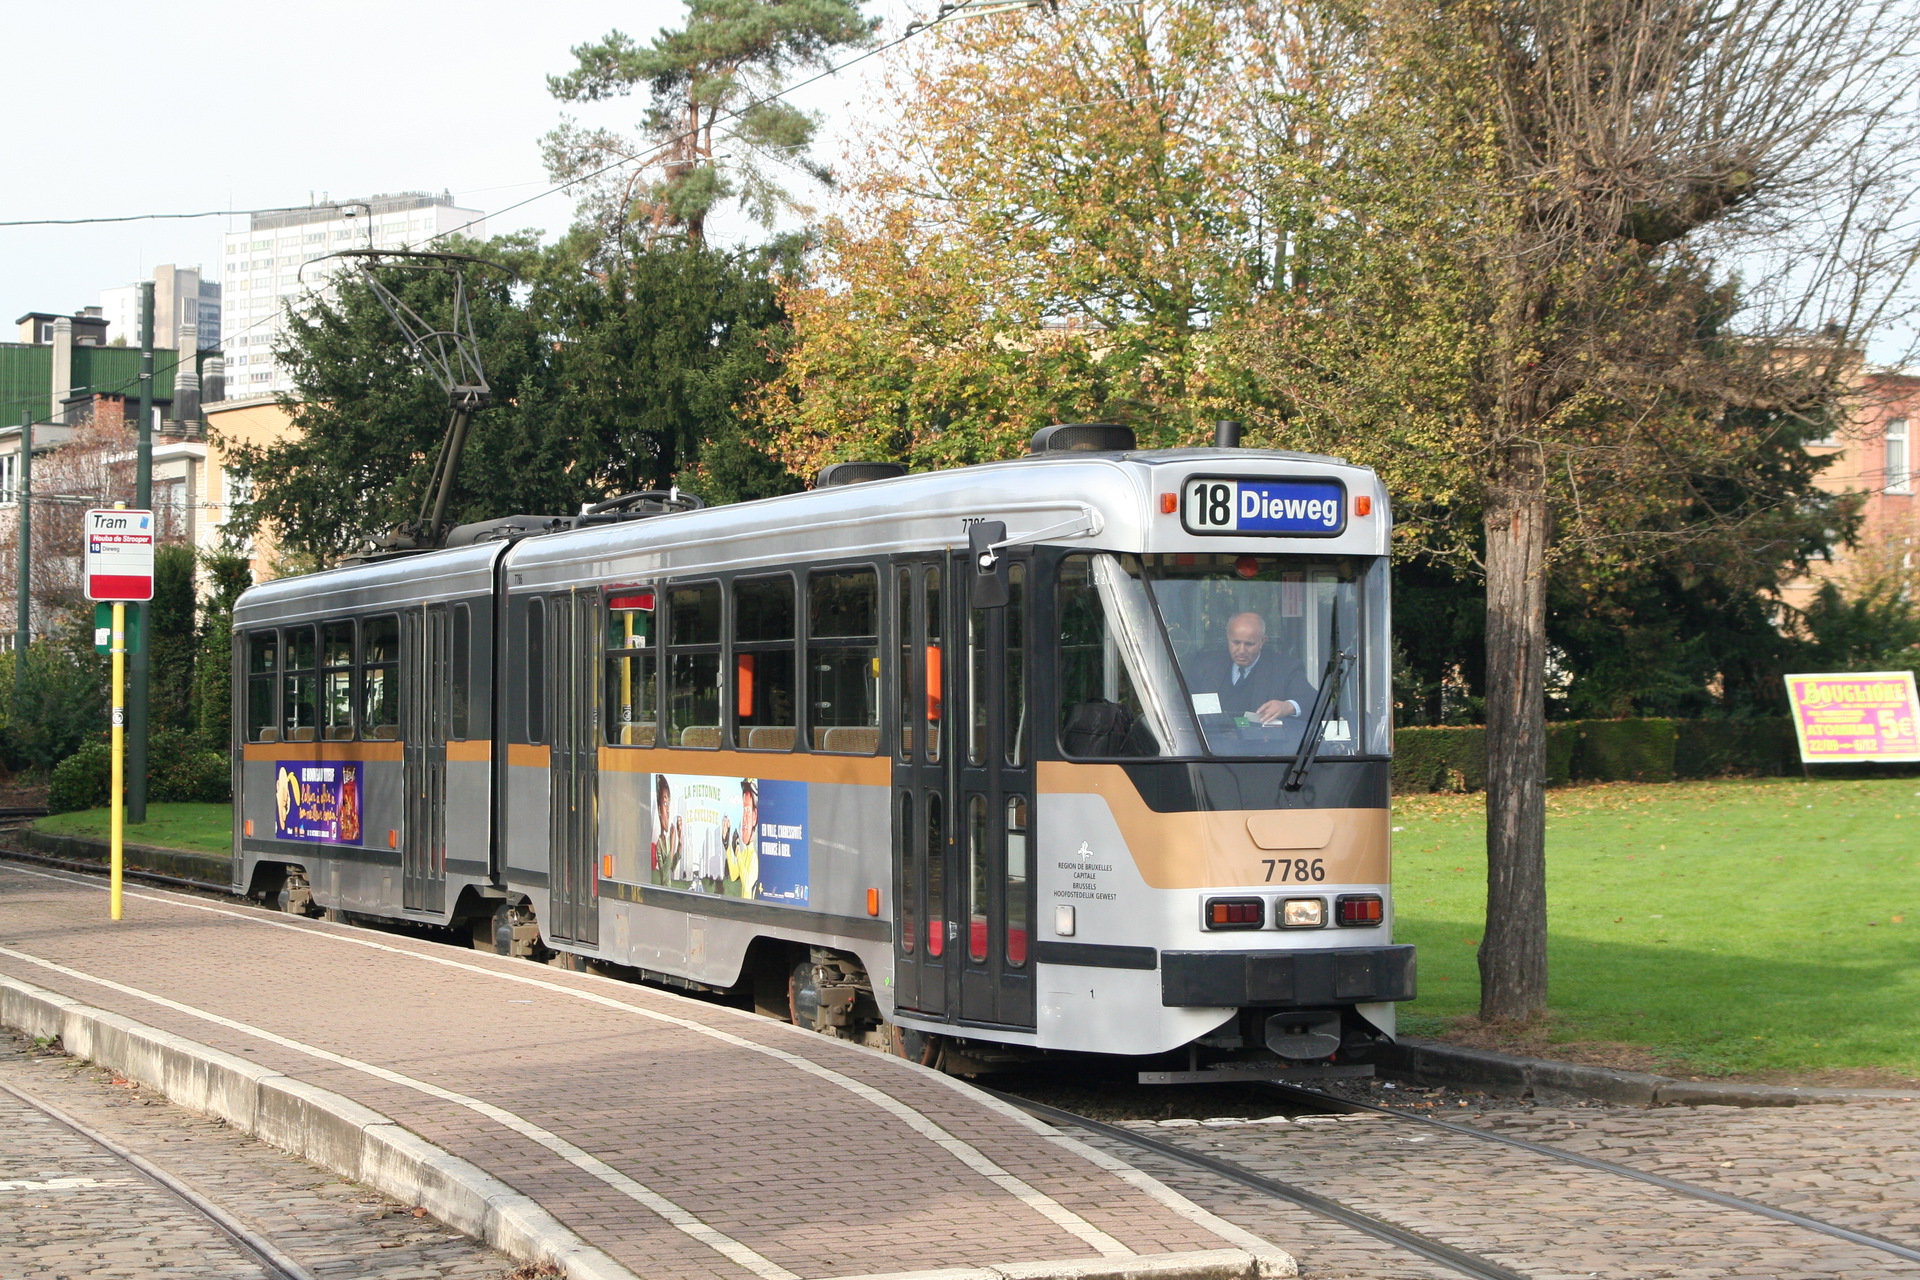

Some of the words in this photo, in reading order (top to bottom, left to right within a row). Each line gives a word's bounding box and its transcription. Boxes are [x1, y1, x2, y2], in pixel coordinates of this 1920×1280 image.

[1194, 484, 1231, 526] 18
[1241, 490, 1338, 527] Dieweg
[94, 515, 127, 528] Tram
[91, 543, 100, 551] 18
[684, 785, 691, 800] LA
[1058, 862, 1076, 870] REGION
[1085, 863, 1112, 871] BRUXELLES
[1262, 858, 1325, 882] 7786
[1073, 882, 1096, 890] BRUSSELS
[1054, 890, 1094, 899] HOOFDSTEDELIJK
[1096, 892, 1116, 900] GEWEST
[1089, 989, 1095, 998] 1
